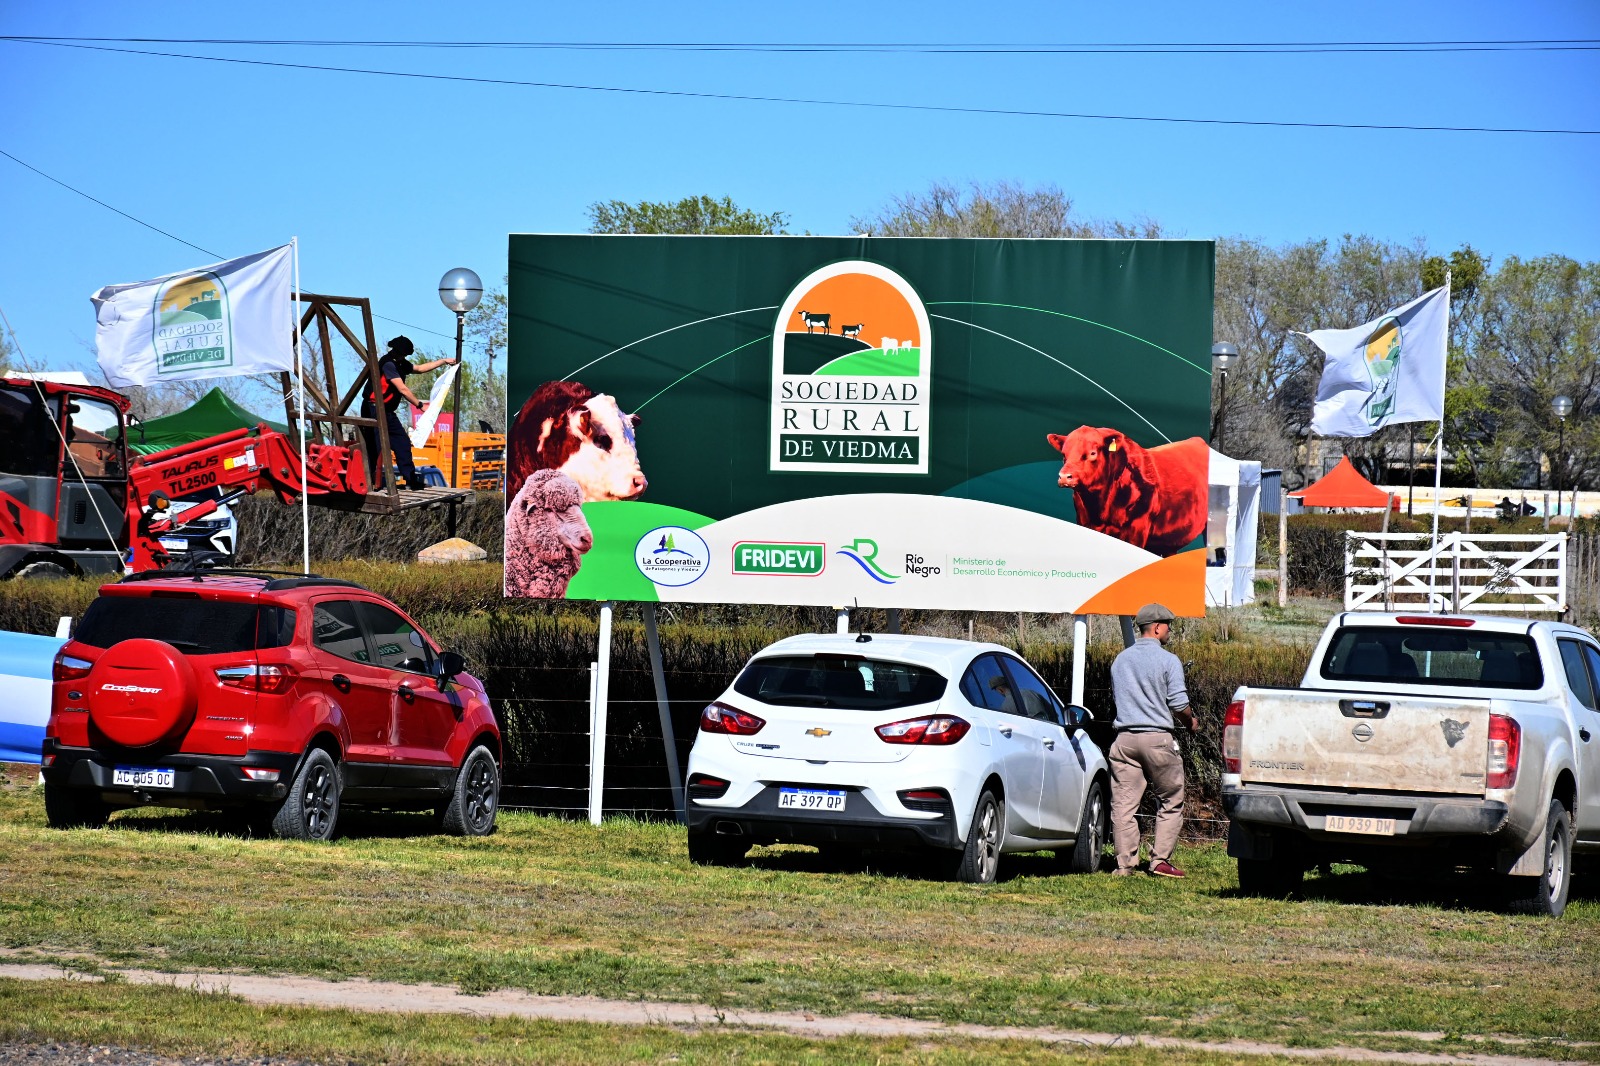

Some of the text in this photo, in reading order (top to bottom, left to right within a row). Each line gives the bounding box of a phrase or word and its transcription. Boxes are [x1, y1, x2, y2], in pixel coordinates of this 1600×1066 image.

[781, 381, 918, 401] SOCIEDAD
[782, 408, 920, 432] RURAL
[784, 439, 914, 459] DE VIEDMA
[161, 455, 219, 480] TAURUS
[169, 471, 217, 494] TL2500
[642, 557, 701, 566] La Cooperativa
[741, 548, 816, 569] FRIDEVI
[953, 557, 1007, 567] Ministerio de
[905, 563, 941, 578] Negro
[953, 567, 1097, 579] Desarrollo Económico y Productivo
[1249, 760, 1305, 770] FRONTIER
[117, 770, 130, 782] AC
[782, 794, 842, 809] AF 397 QP
[1329, 817, 1392, 833] AD 939 DW
